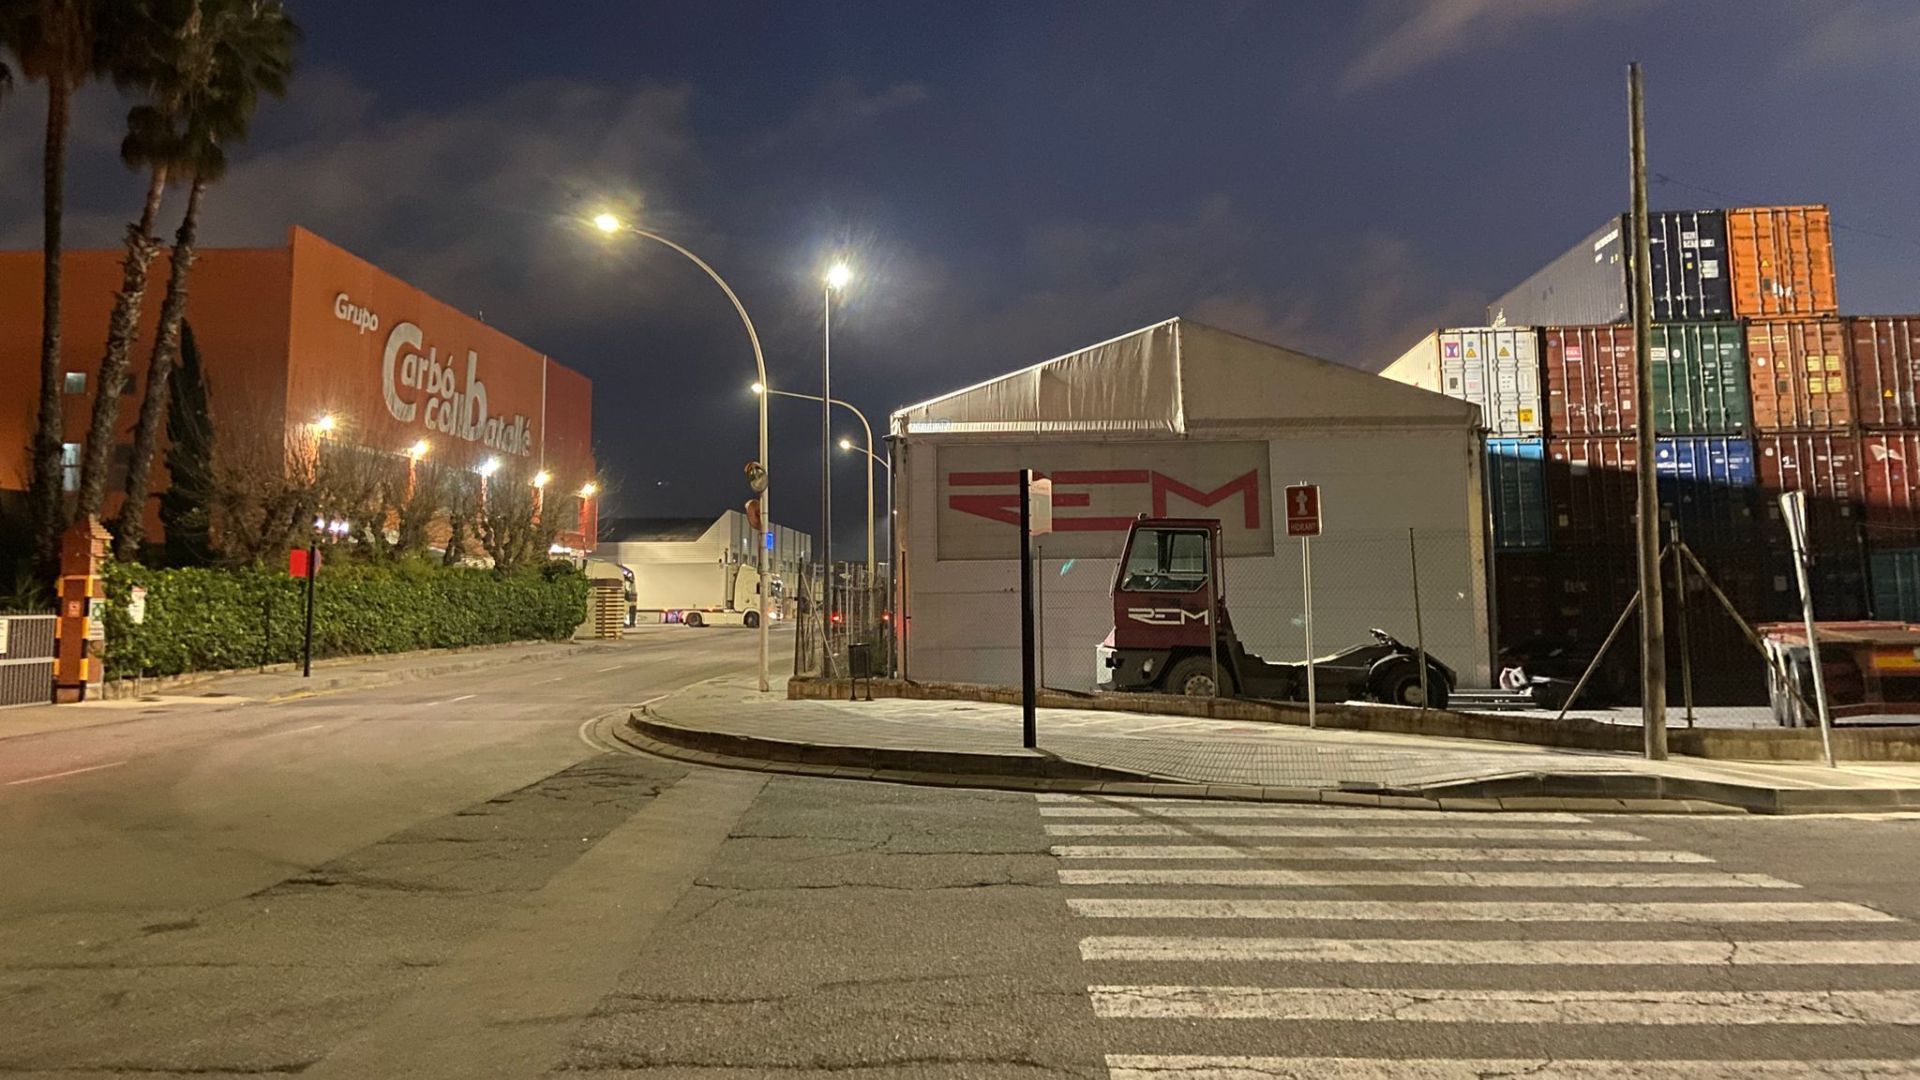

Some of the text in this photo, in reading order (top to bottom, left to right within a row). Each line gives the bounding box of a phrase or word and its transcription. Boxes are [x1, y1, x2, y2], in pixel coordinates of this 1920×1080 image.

[334, 293, 379, 335] Grupo
[382, 322, 455, 422] Carbó
[1128, 608, 1209, 625] REM
